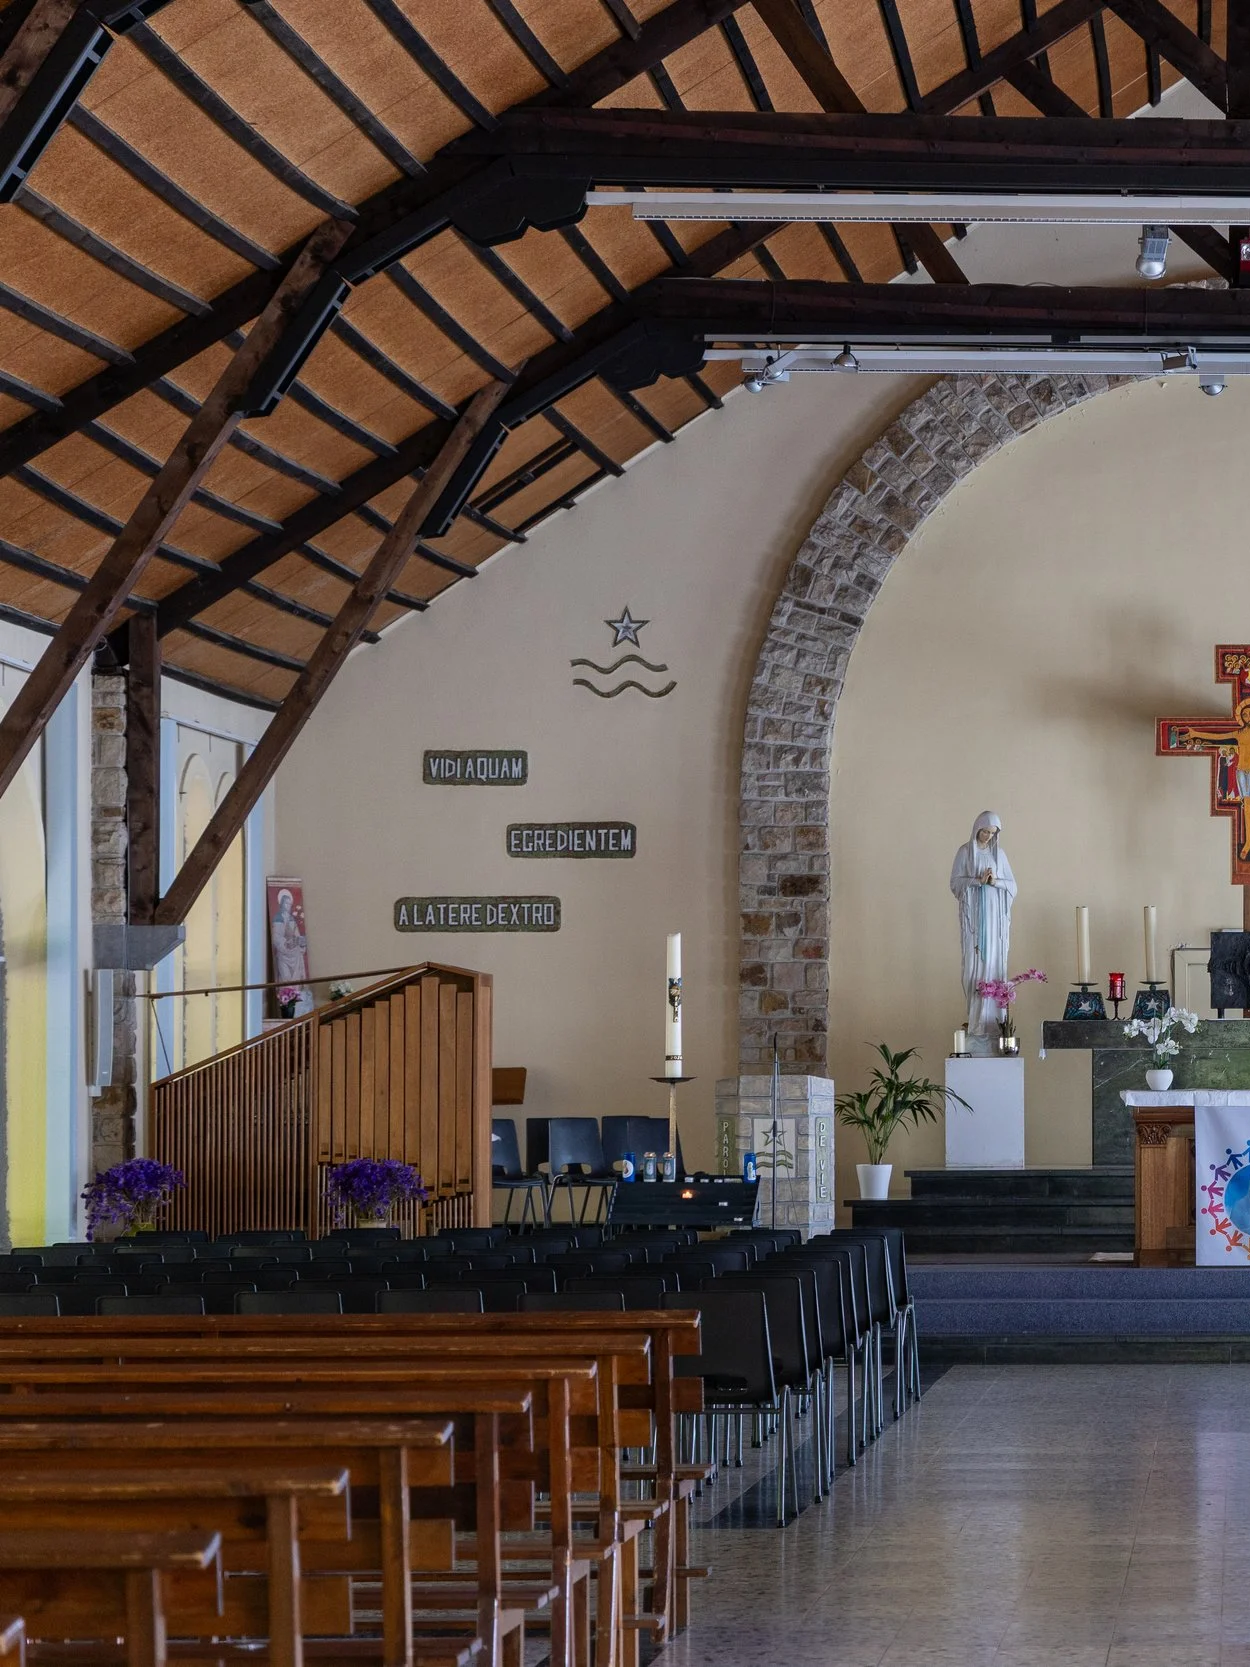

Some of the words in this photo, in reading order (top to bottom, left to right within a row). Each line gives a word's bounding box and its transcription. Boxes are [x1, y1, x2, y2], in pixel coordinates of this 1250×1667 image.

[429, 758, 461, 779] VIDI
[465, 757, 522, 781] AQUAM
[510, 829, 632, 852] EGREDIENTEM
[399, 904, 409, 925] A
[413, 904, 482, 925] LATERE
[486, 903, 554, 925] DEXTRO
[819, 1121, 826, 1147] DE
[819, 1159, 827, 1198] VIE
